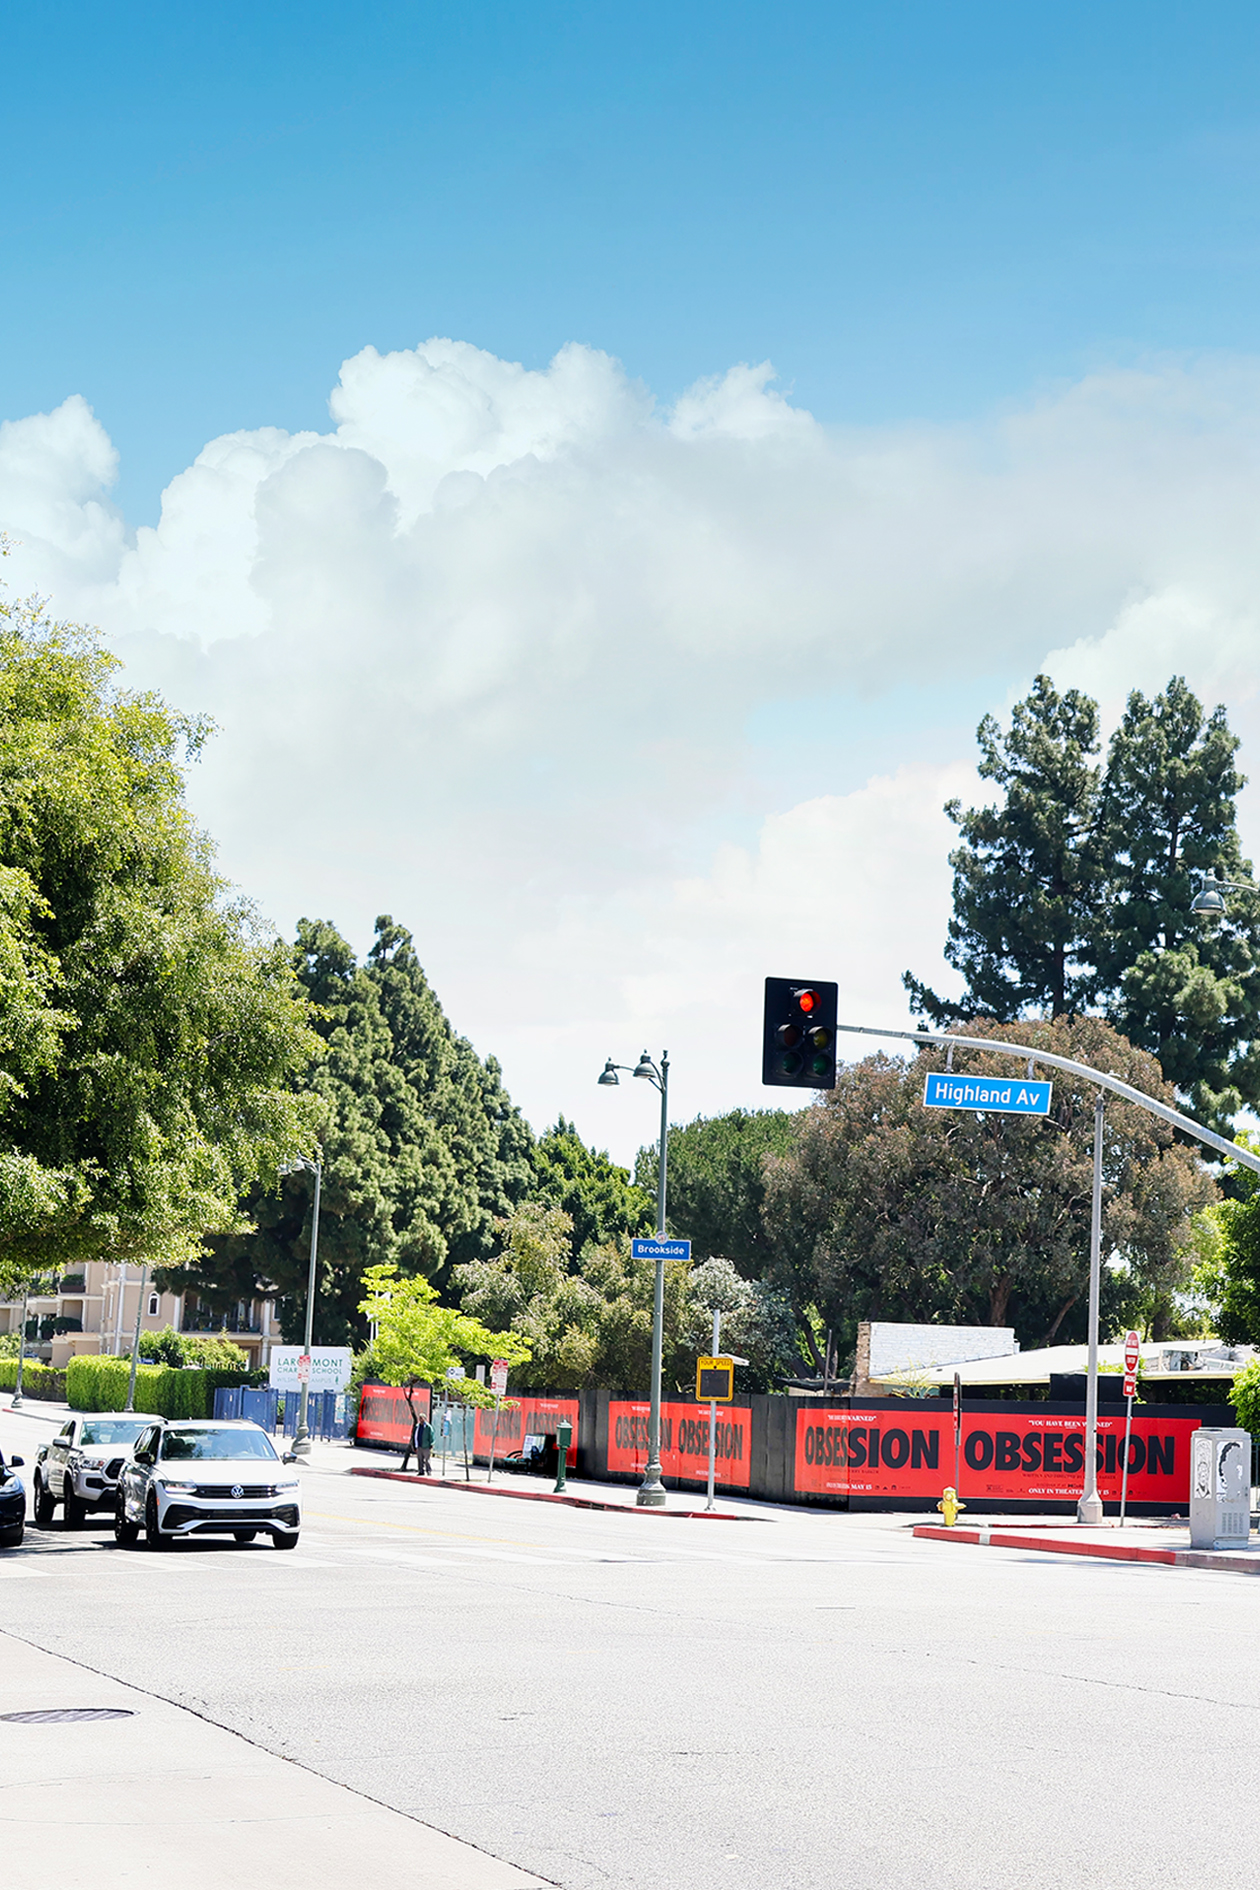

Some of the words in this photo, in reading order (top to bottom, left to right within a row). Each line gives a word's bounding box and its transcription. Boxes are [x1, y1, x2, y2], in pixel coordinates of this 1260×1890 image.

[936, 1082, 1011, 1105] Highland
[1016, 1088, 1040, 1106] Av
[637, 1244, 685, 1255] Brookside
[278, 1358, 343, 1367] LARMONT
[679, 1418, 743, 1460] OBSESION
[805, 1426, 940, 1469] OBSESSION
[1055, 1488, 1084, 1496] THEATER
